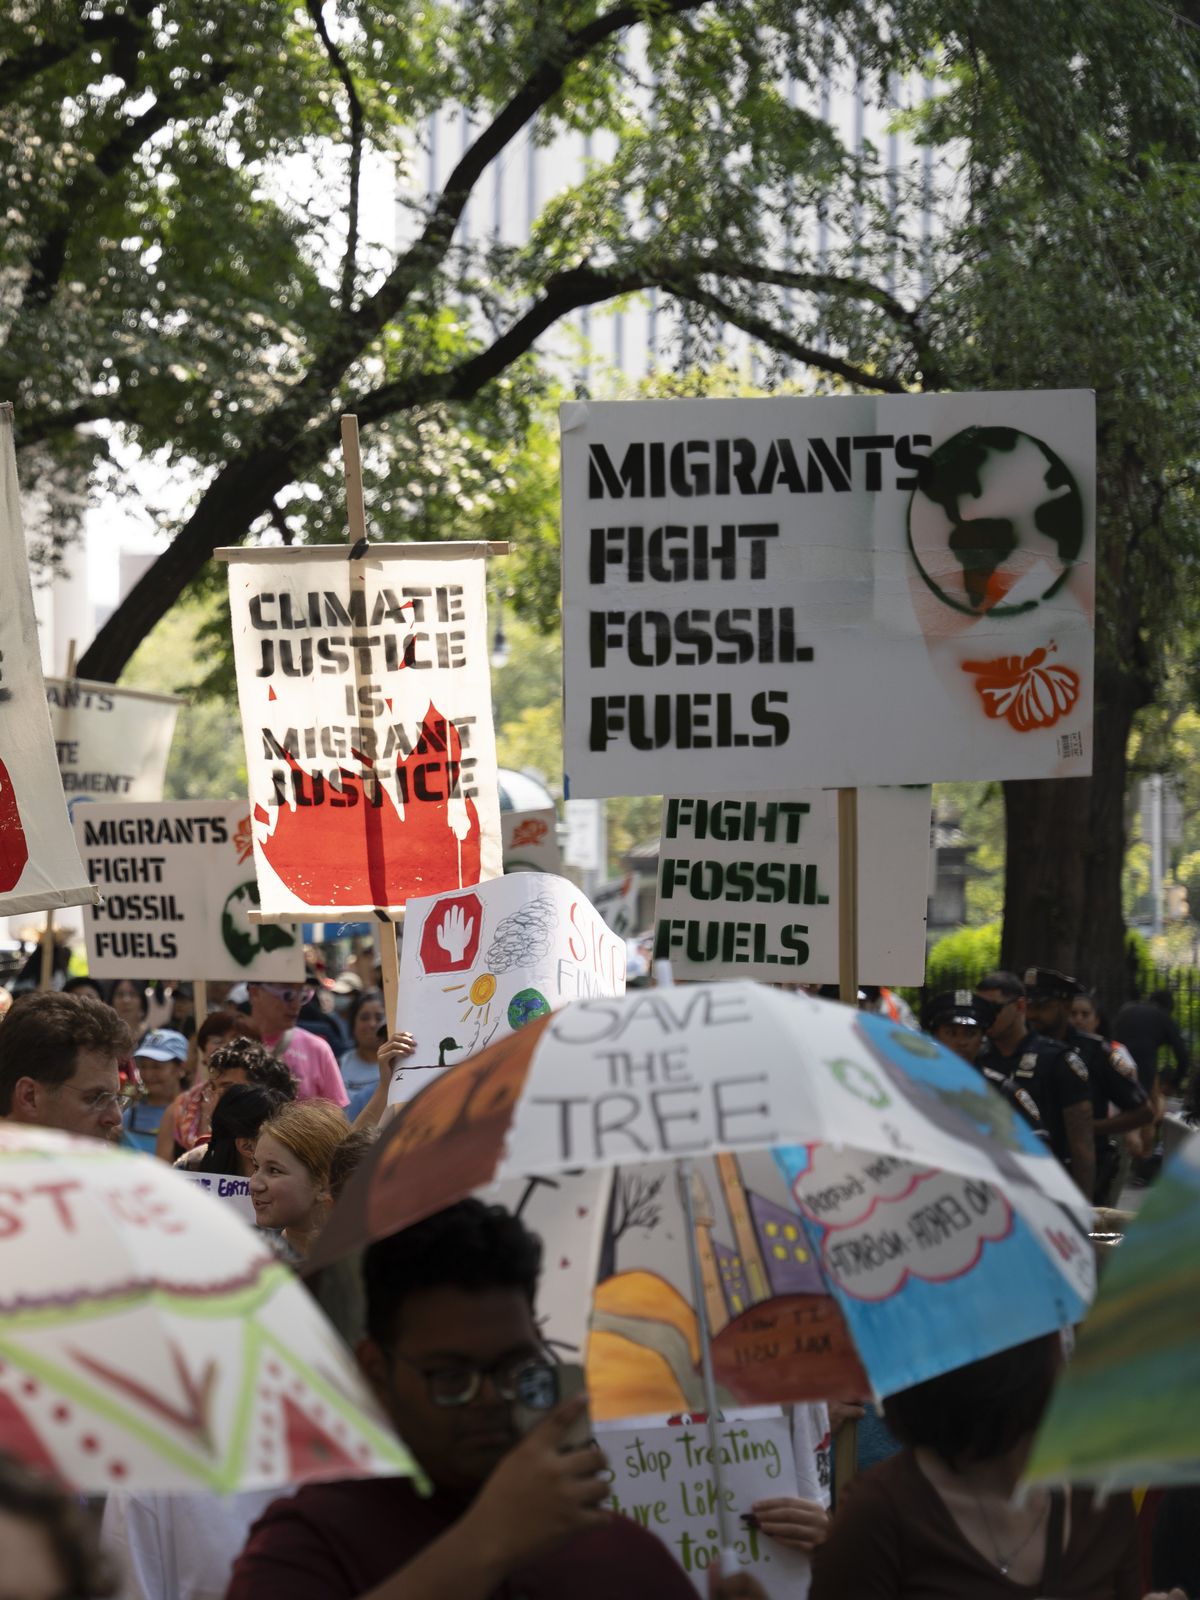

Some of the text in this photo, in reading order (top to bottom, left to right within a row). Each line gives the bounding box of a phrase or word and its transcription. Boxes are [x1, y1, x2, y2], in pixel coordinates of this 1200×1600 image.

[588, 434, 936, 500] MIGRANTS
[589, 523, 779, 584] FIGHT
[249, 586, 466, 631] CLIMATE
[256, 630, 466, 678] JUSTICE
[589, 607, 815, 668] FOSSIL
[47, 683, 114, 712] ANTS
[345, 684, 385, 718] IS
[262, 715, 477, 761] MIGRANT
[589, 690, 790, 752] FUELS
[63, 771, 135, 794] EMENT
[268, 757, 479, 808] JUSTICE
[84, 817, 229, 847] MIGRANTS
[665, 798, 811, 844] FIGHT
[88, 857, 166, 883] FIGHT
[660, 858, 830, 905] FOSSIL
[92, 895, 185, 921] FOSSIL
[95, 932, 179, 960] FUELS
[653, 919, 811, 966] FUELS
[552, 988, 753, 1045] SAVE
[593, 1046, 695, 1088] THE
[531, 1072, 781, 1162] TREE
[625, 1436, 672, 1482] stop
[676, 1429, 782, 1480] treating
